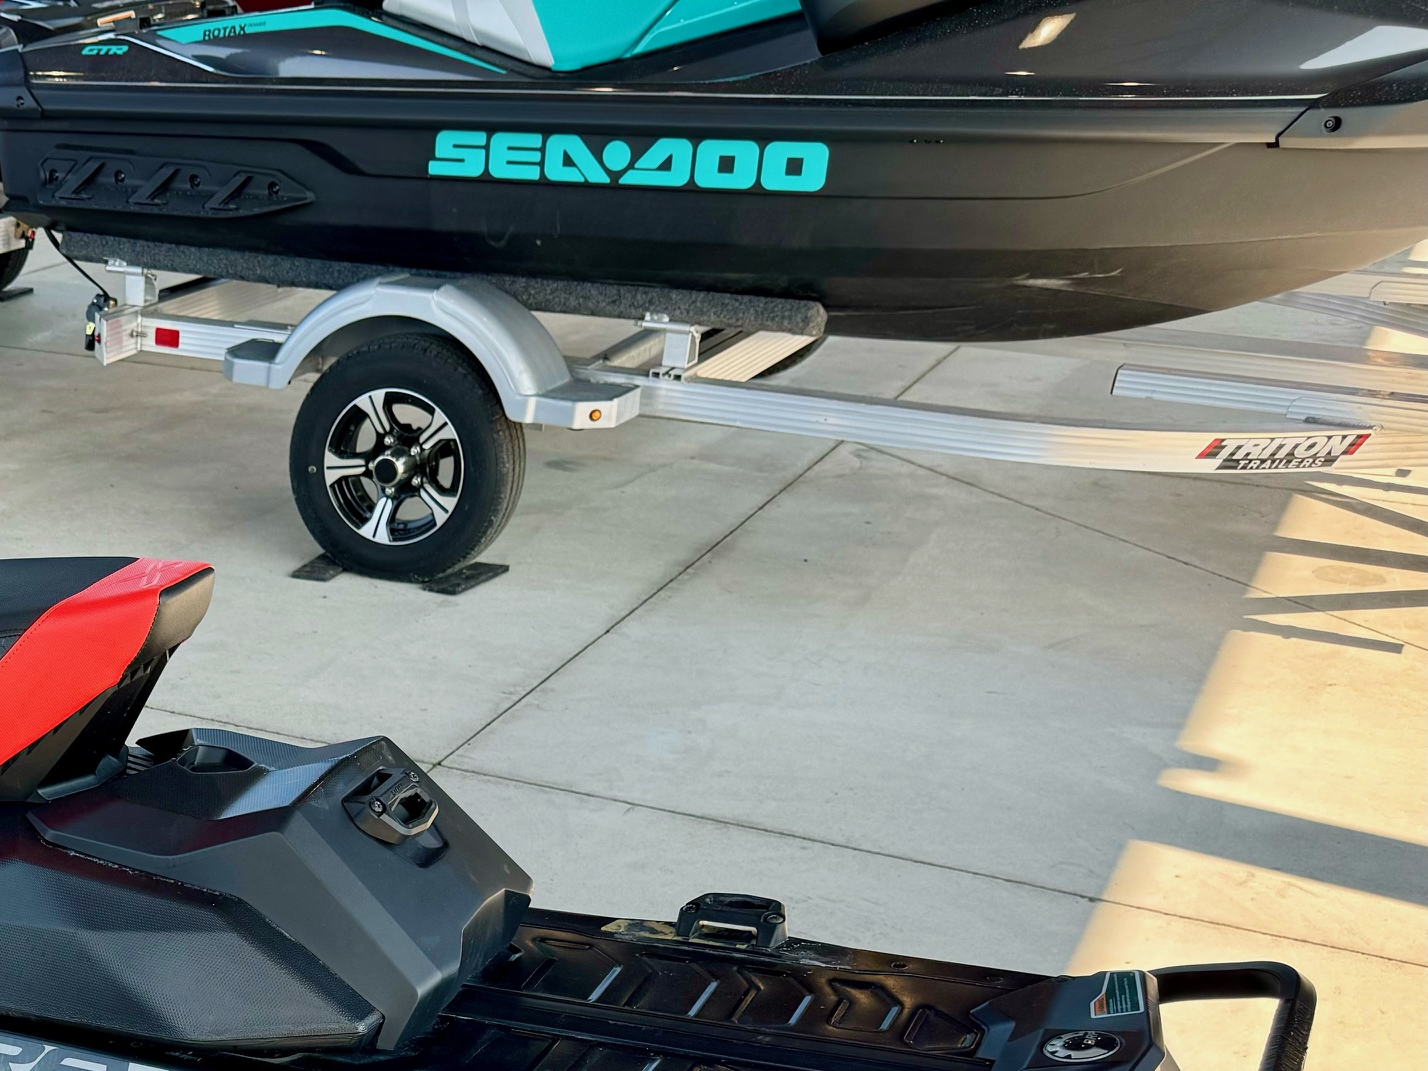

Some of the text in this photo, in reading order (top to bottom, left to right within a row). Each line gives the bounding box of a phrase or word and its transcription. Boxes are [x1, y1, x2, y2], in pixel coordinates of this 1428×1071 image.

[202, 23, 248, 41] ROTAX
[81, 45, 129, 56] GTR
[1216, 435, 1357, 459] TRITON
[1237, 457, 1325, 470] TRAILERS
